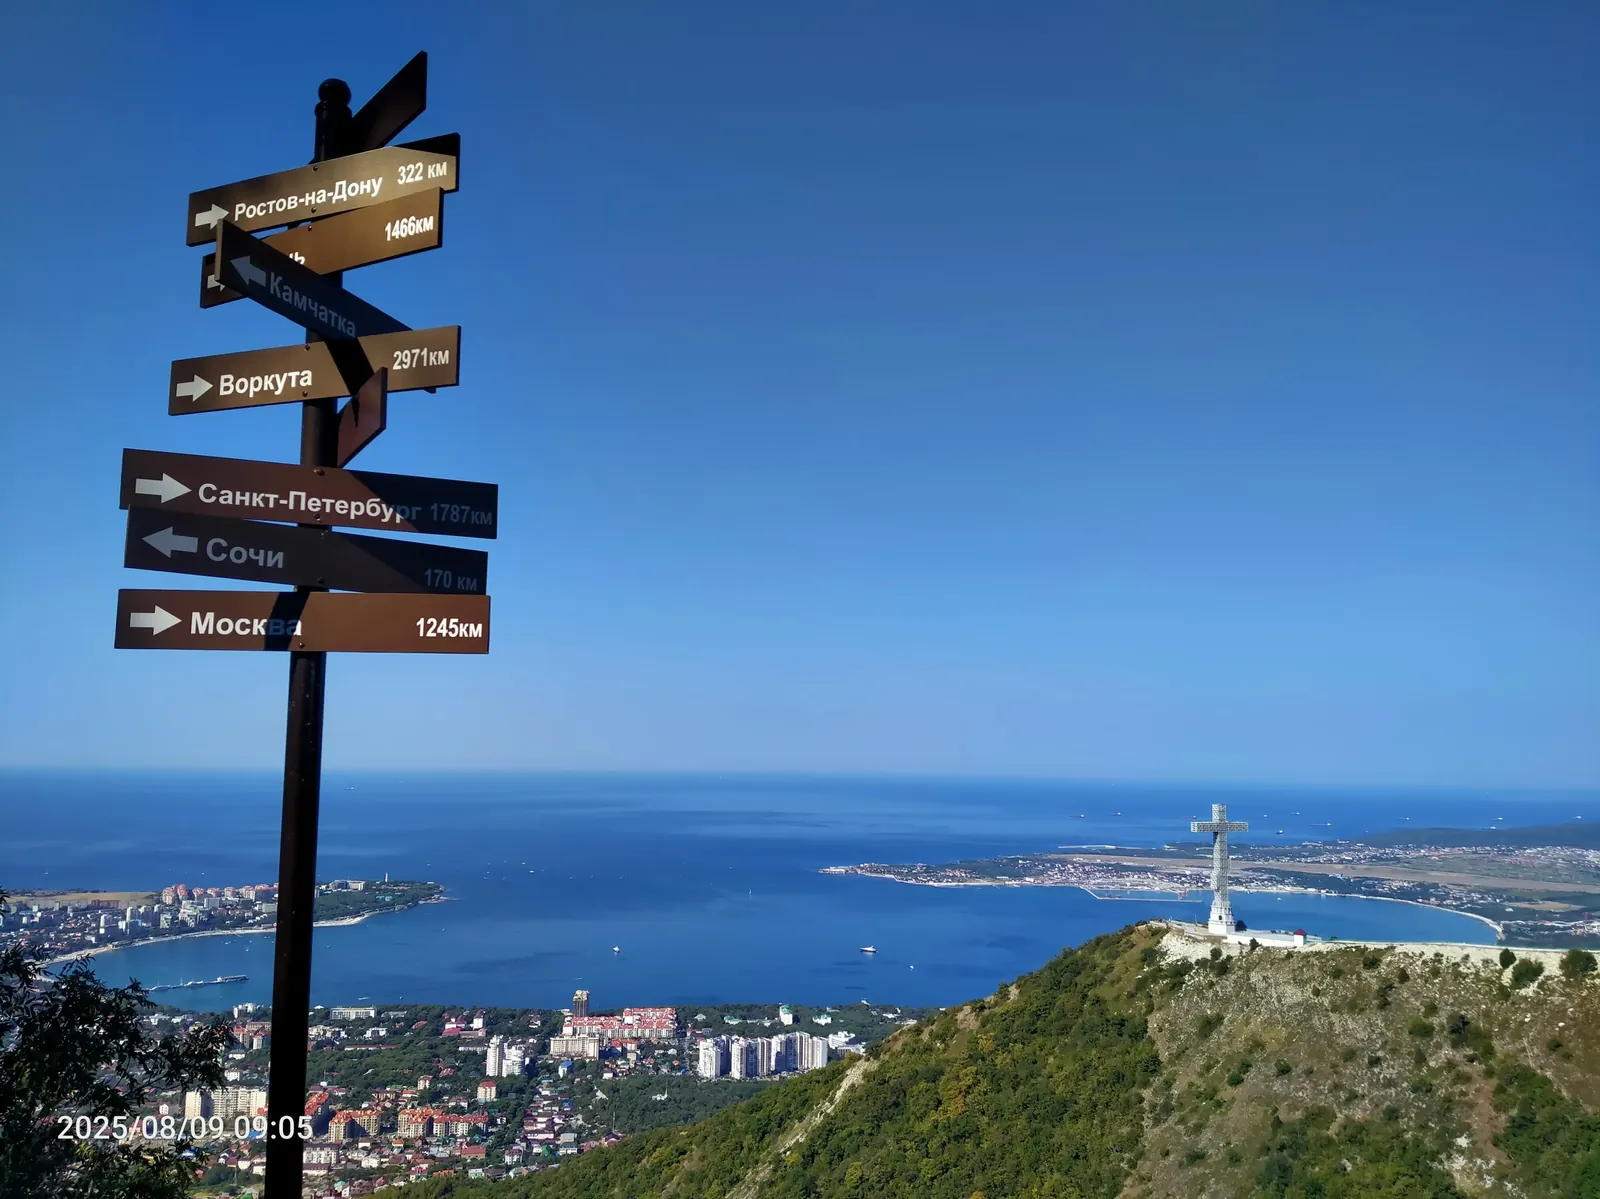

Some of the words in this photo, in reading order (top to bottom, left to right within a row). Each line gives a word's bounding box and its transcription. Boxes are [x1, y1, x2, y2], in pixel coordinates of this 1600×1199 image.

[234, 175, 383, 221] Ростов-на-Дону
[397, 162, 424, 185] 322
[384, 215, 434, 242] 1466км
[269, 271, 357, 338] Камчатка
[218, 368, 313, 397] Воркута
[392, 348, 450, 370] 2971км
[198, 483, 421, 525] Санкт-Петербург
[430, 502, 493, 526] 1787км
[206, 537, 284, 569] Сочи
[424, 568, 452, 589] 170
[190, 612, 302, 636] Москва
[416, 617, 483, 638] 1245км
